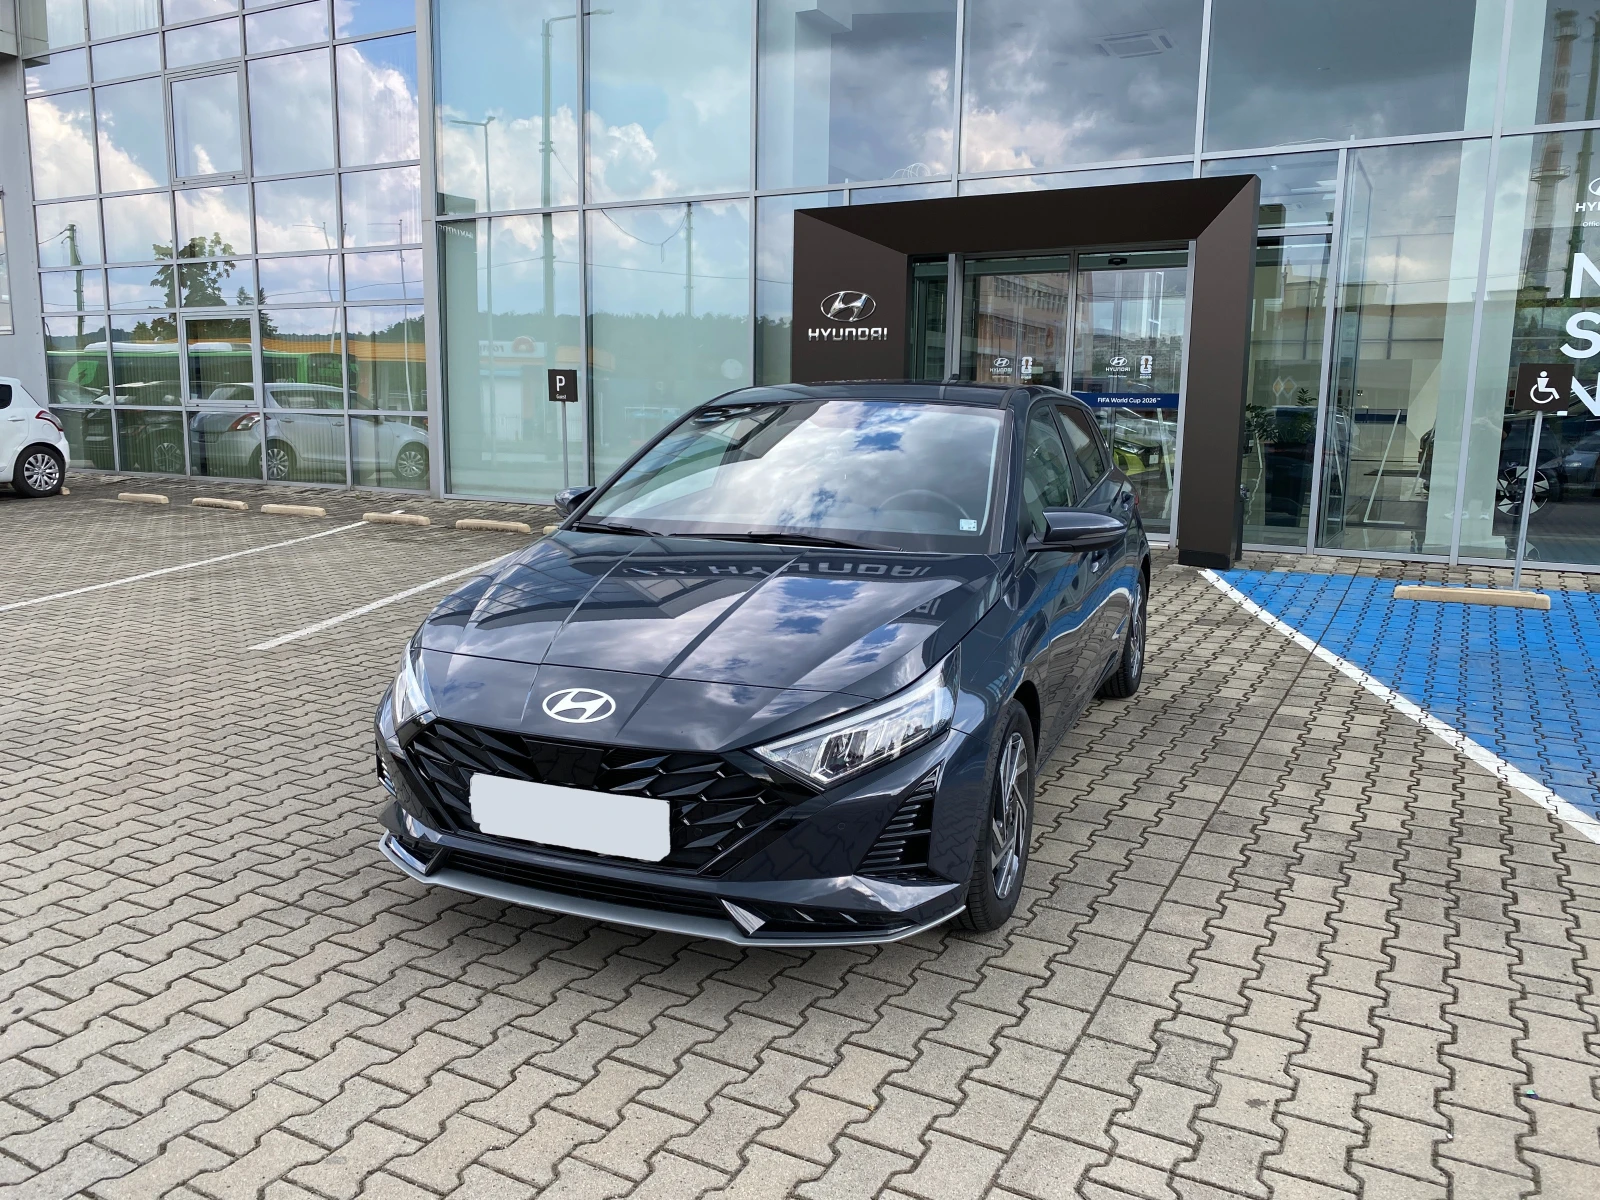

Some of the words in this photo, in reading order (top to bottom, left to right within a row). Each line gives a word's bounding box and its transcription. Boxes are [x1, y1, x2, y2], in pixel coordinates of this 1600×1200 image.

[1575, 201, 1600, 213] HY
[808, 327, 888, 341] HYUNDAI
[556, 375, 565, 391] P
[1128, 397, 1142, 405] Cup
